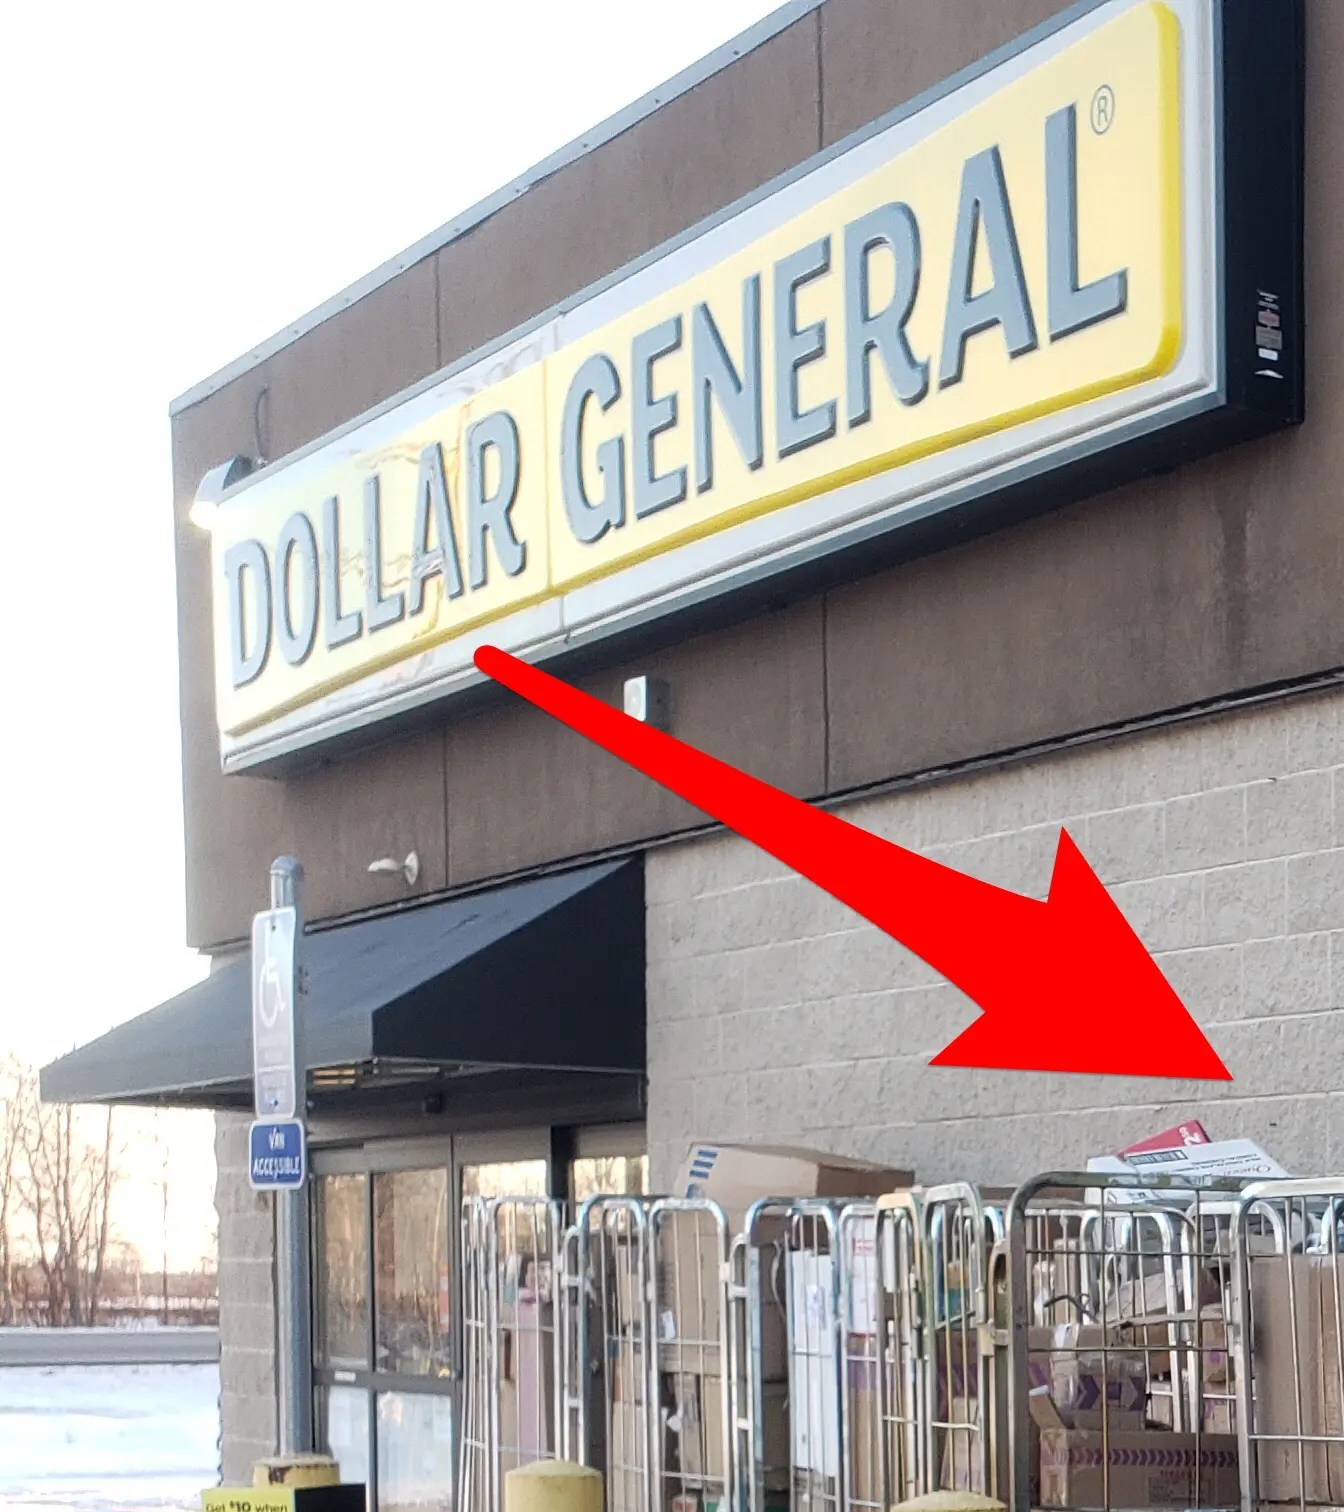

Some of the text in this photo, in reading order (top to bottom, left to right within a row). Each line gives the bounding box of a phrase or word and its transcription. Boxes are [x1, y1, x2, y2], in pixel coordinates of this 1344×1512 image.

[223, 102, 1128, 689] DOLLAR GENERAL
[269, 1129, 285, 1150] VAN
[253, 1155, 300, 1177] ACCESSIBLE
